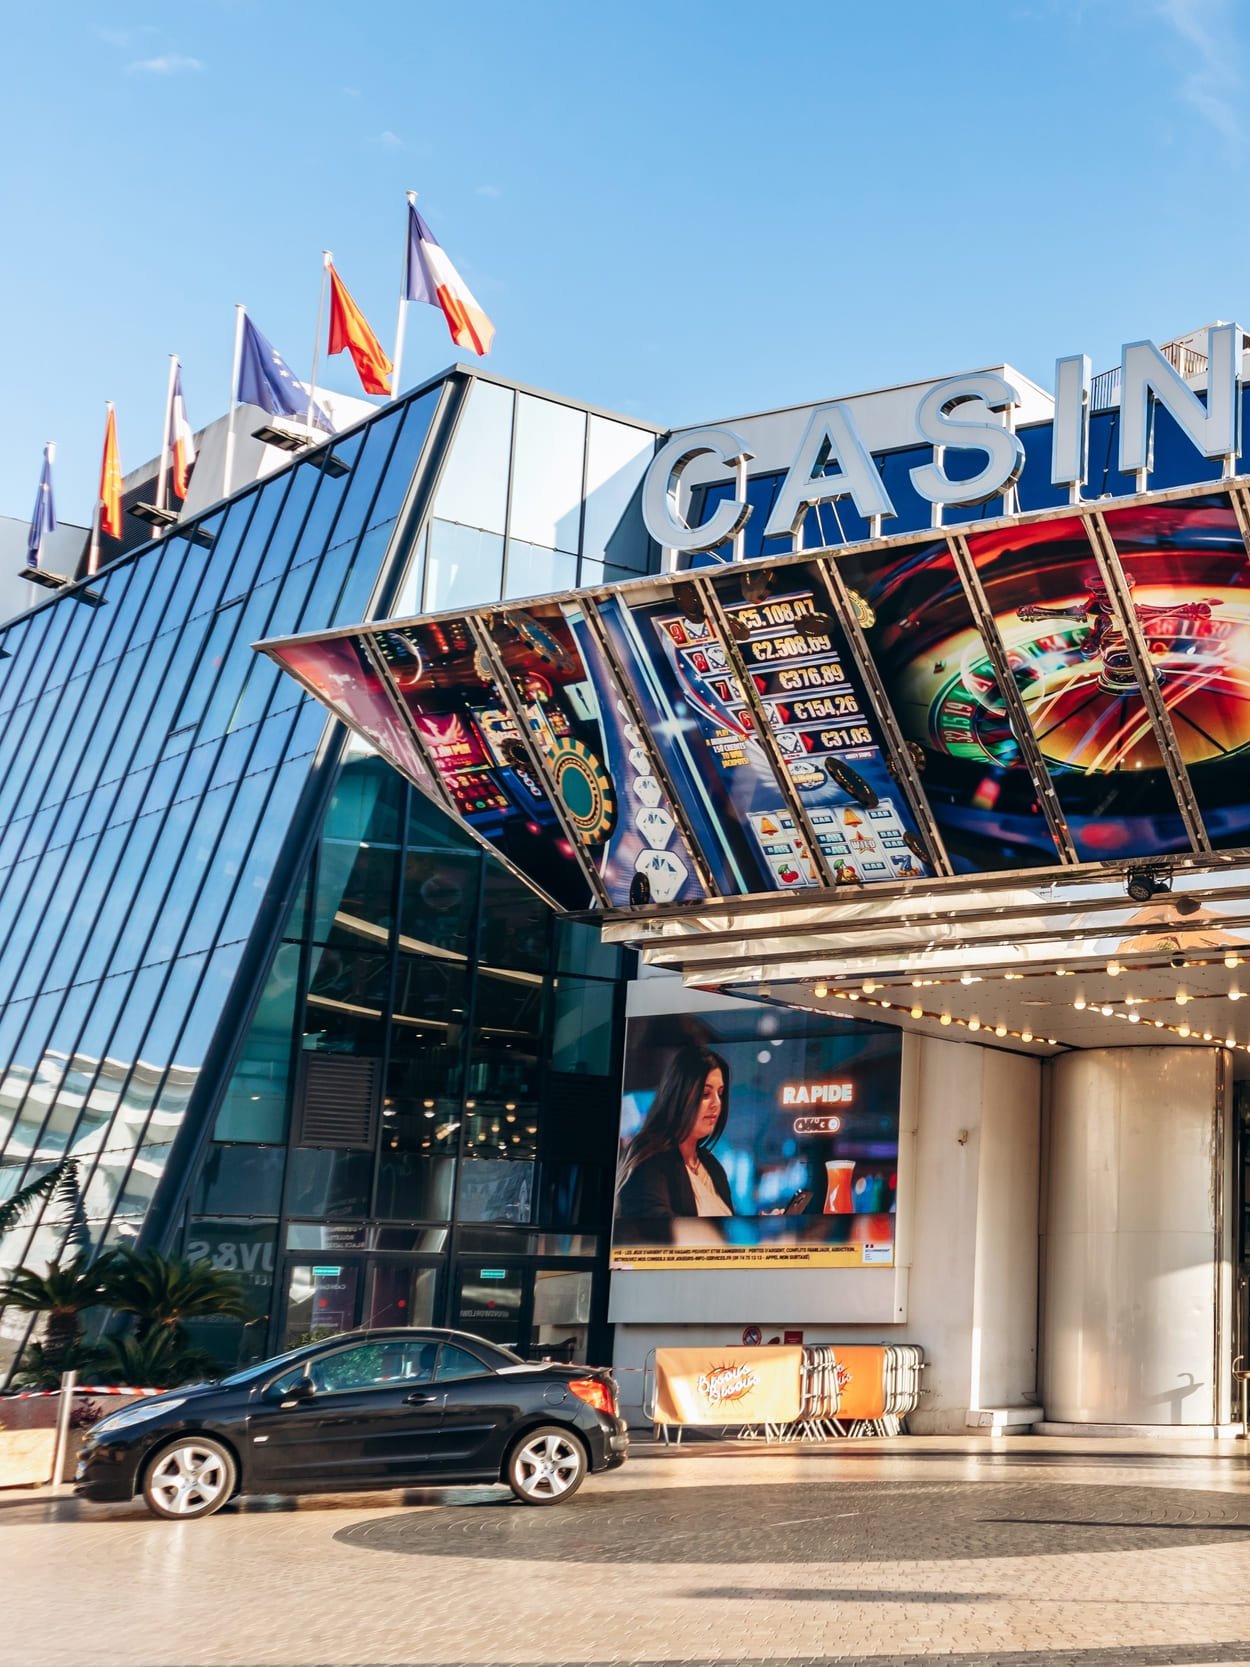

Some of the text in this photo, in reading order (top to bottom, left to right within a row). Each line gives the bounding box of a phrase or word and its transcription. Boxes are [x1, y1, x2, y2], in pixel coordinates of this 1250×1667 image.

[779, 664, 845, 690] €376,89
[793, 695, 859, 721] €154,26
[820, 727, 873, 749] €31,03
[783, 1084, 853, 1104] RAPIDE
